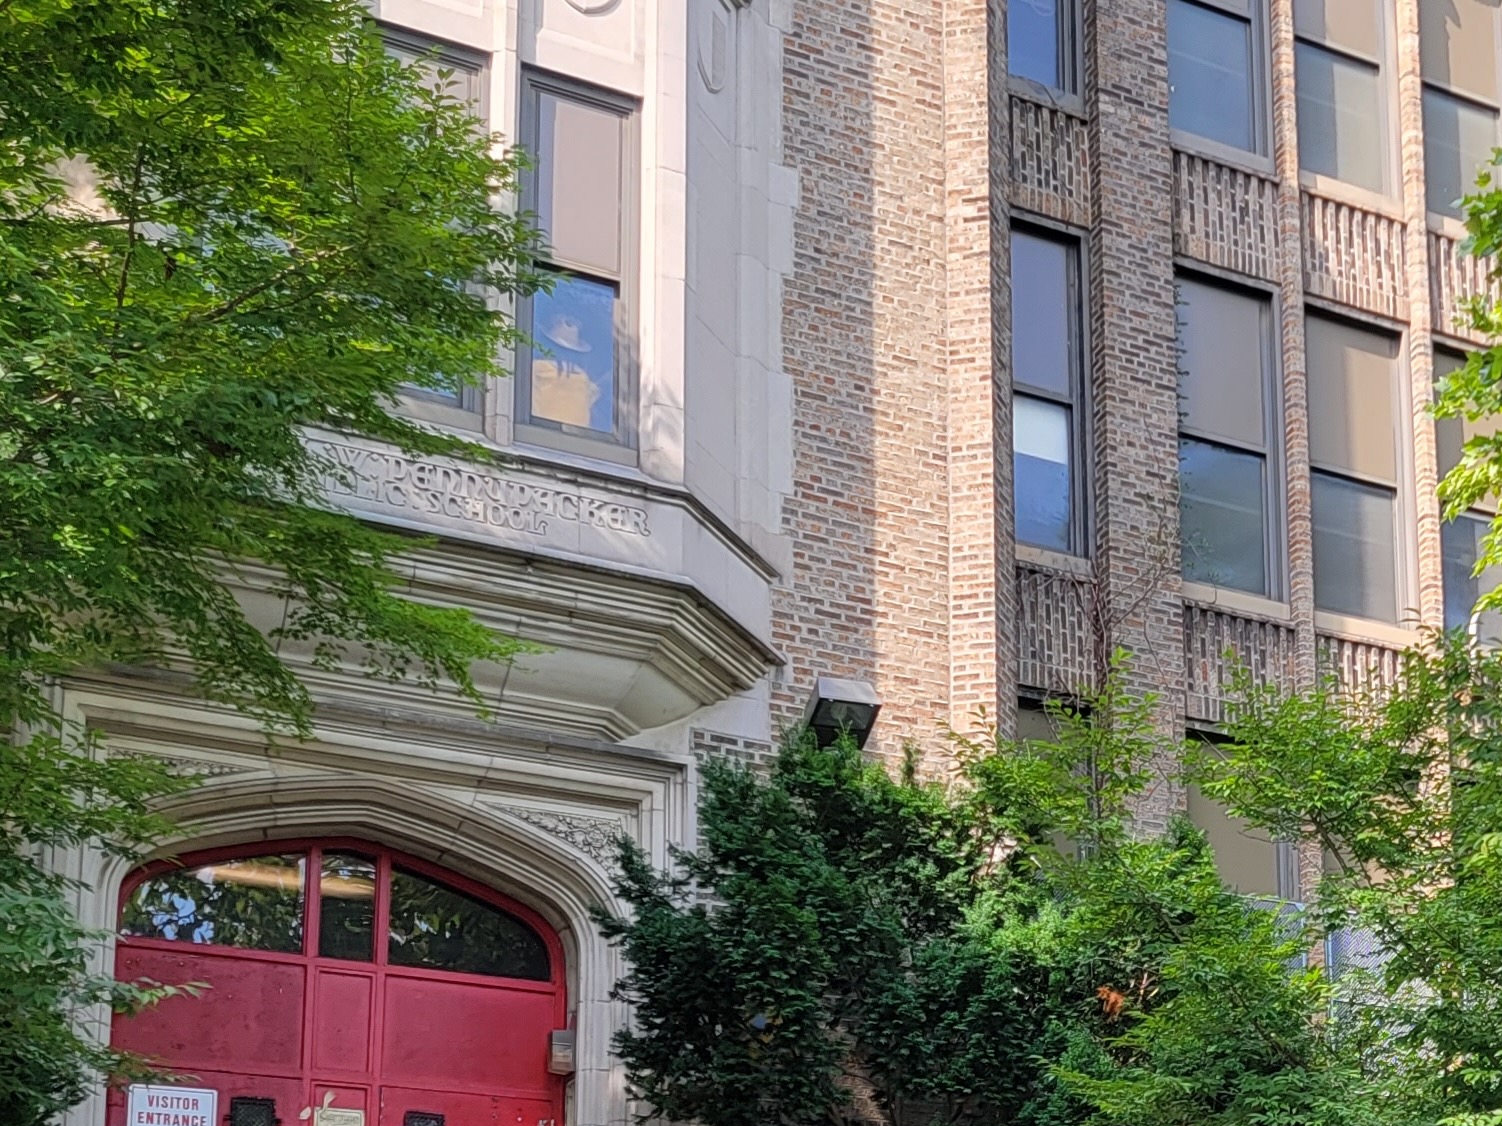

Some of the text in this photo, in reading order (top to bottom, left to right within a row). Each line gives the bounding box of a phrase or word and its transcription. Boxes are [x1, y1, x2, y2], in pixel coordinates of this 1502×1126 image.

[384, 456, 652, 537] PENNYPACKER
[424, 488, 549, 536] SCHOOL
[147, 1094, 199, 1111] VISITOR
